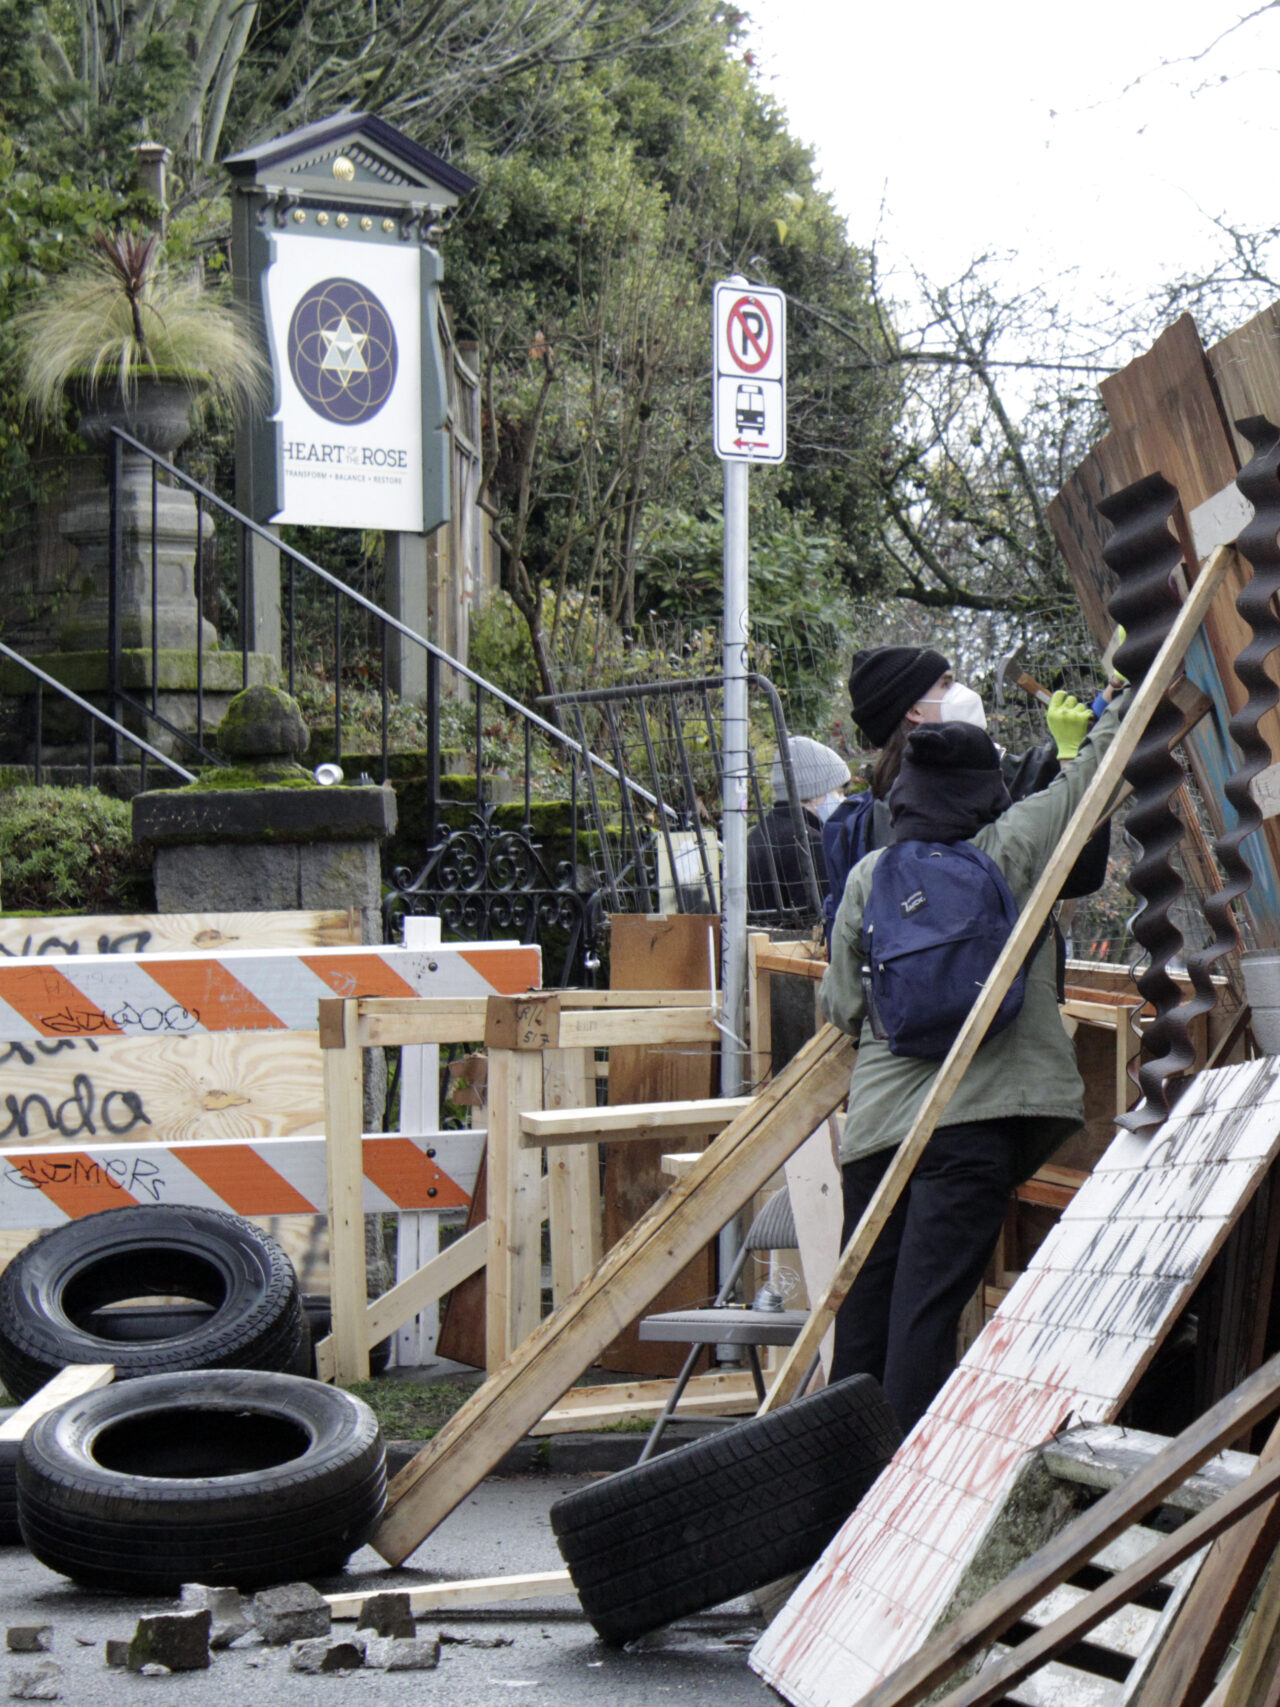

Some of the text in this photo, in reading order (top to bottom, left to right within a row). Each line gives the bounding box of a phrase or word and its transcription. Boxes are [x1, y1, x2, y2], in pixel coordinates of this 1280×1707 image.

[283, 441, 407, 468] HEART OF THE ROSE
[285, 470, 402, 485] TRANSFORM BALANCE RESTORE
